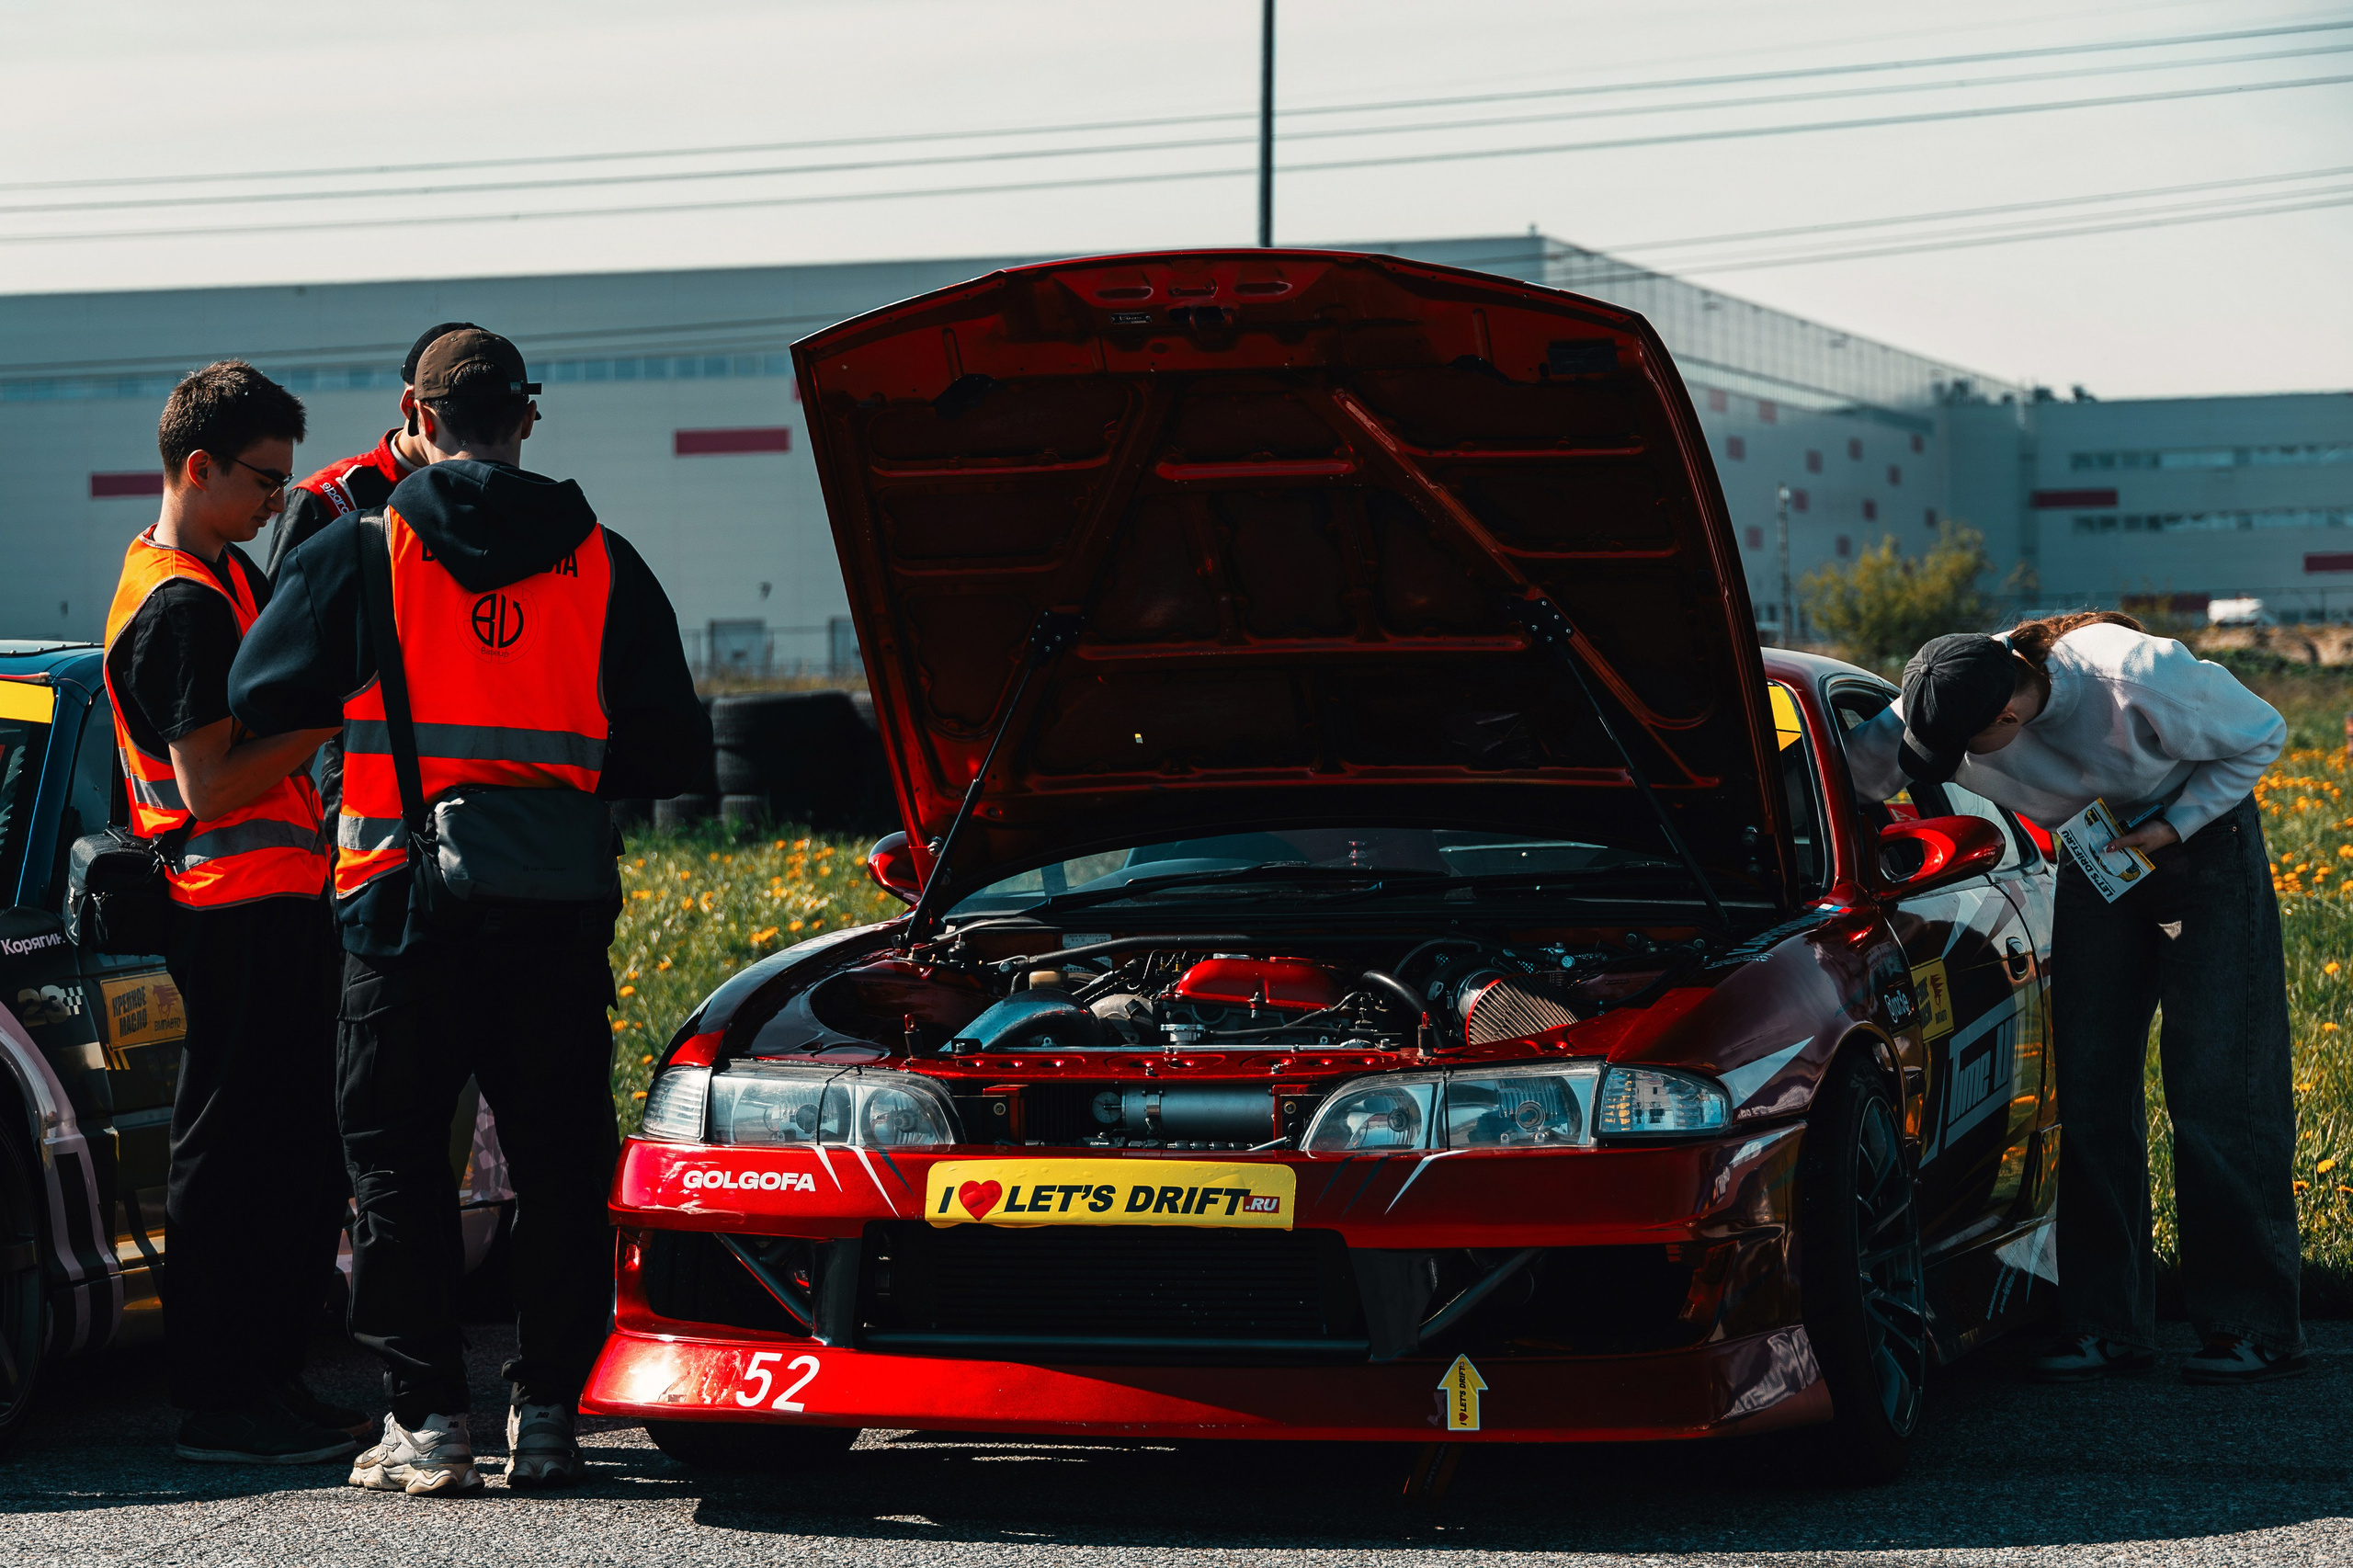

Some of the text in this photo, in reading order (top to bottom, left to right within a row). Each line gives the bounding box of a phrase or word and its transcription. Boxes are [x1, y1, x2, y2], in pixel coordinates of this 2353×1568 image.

[2090, 872, 2114, 898] LET'S
[17, 984, 69, 1028] 23
[112, 987, 147, 1017] КРЕПКОЕ
[119, 1009, 148, 1038] МАСЛО
[682, 1170, 816, 1192] GOLGOFA
[938, 1186, 955, 1214] I
[1003, 1184, 1117, 1214] LET'S
[735, 1351, 821, 1413] 52
